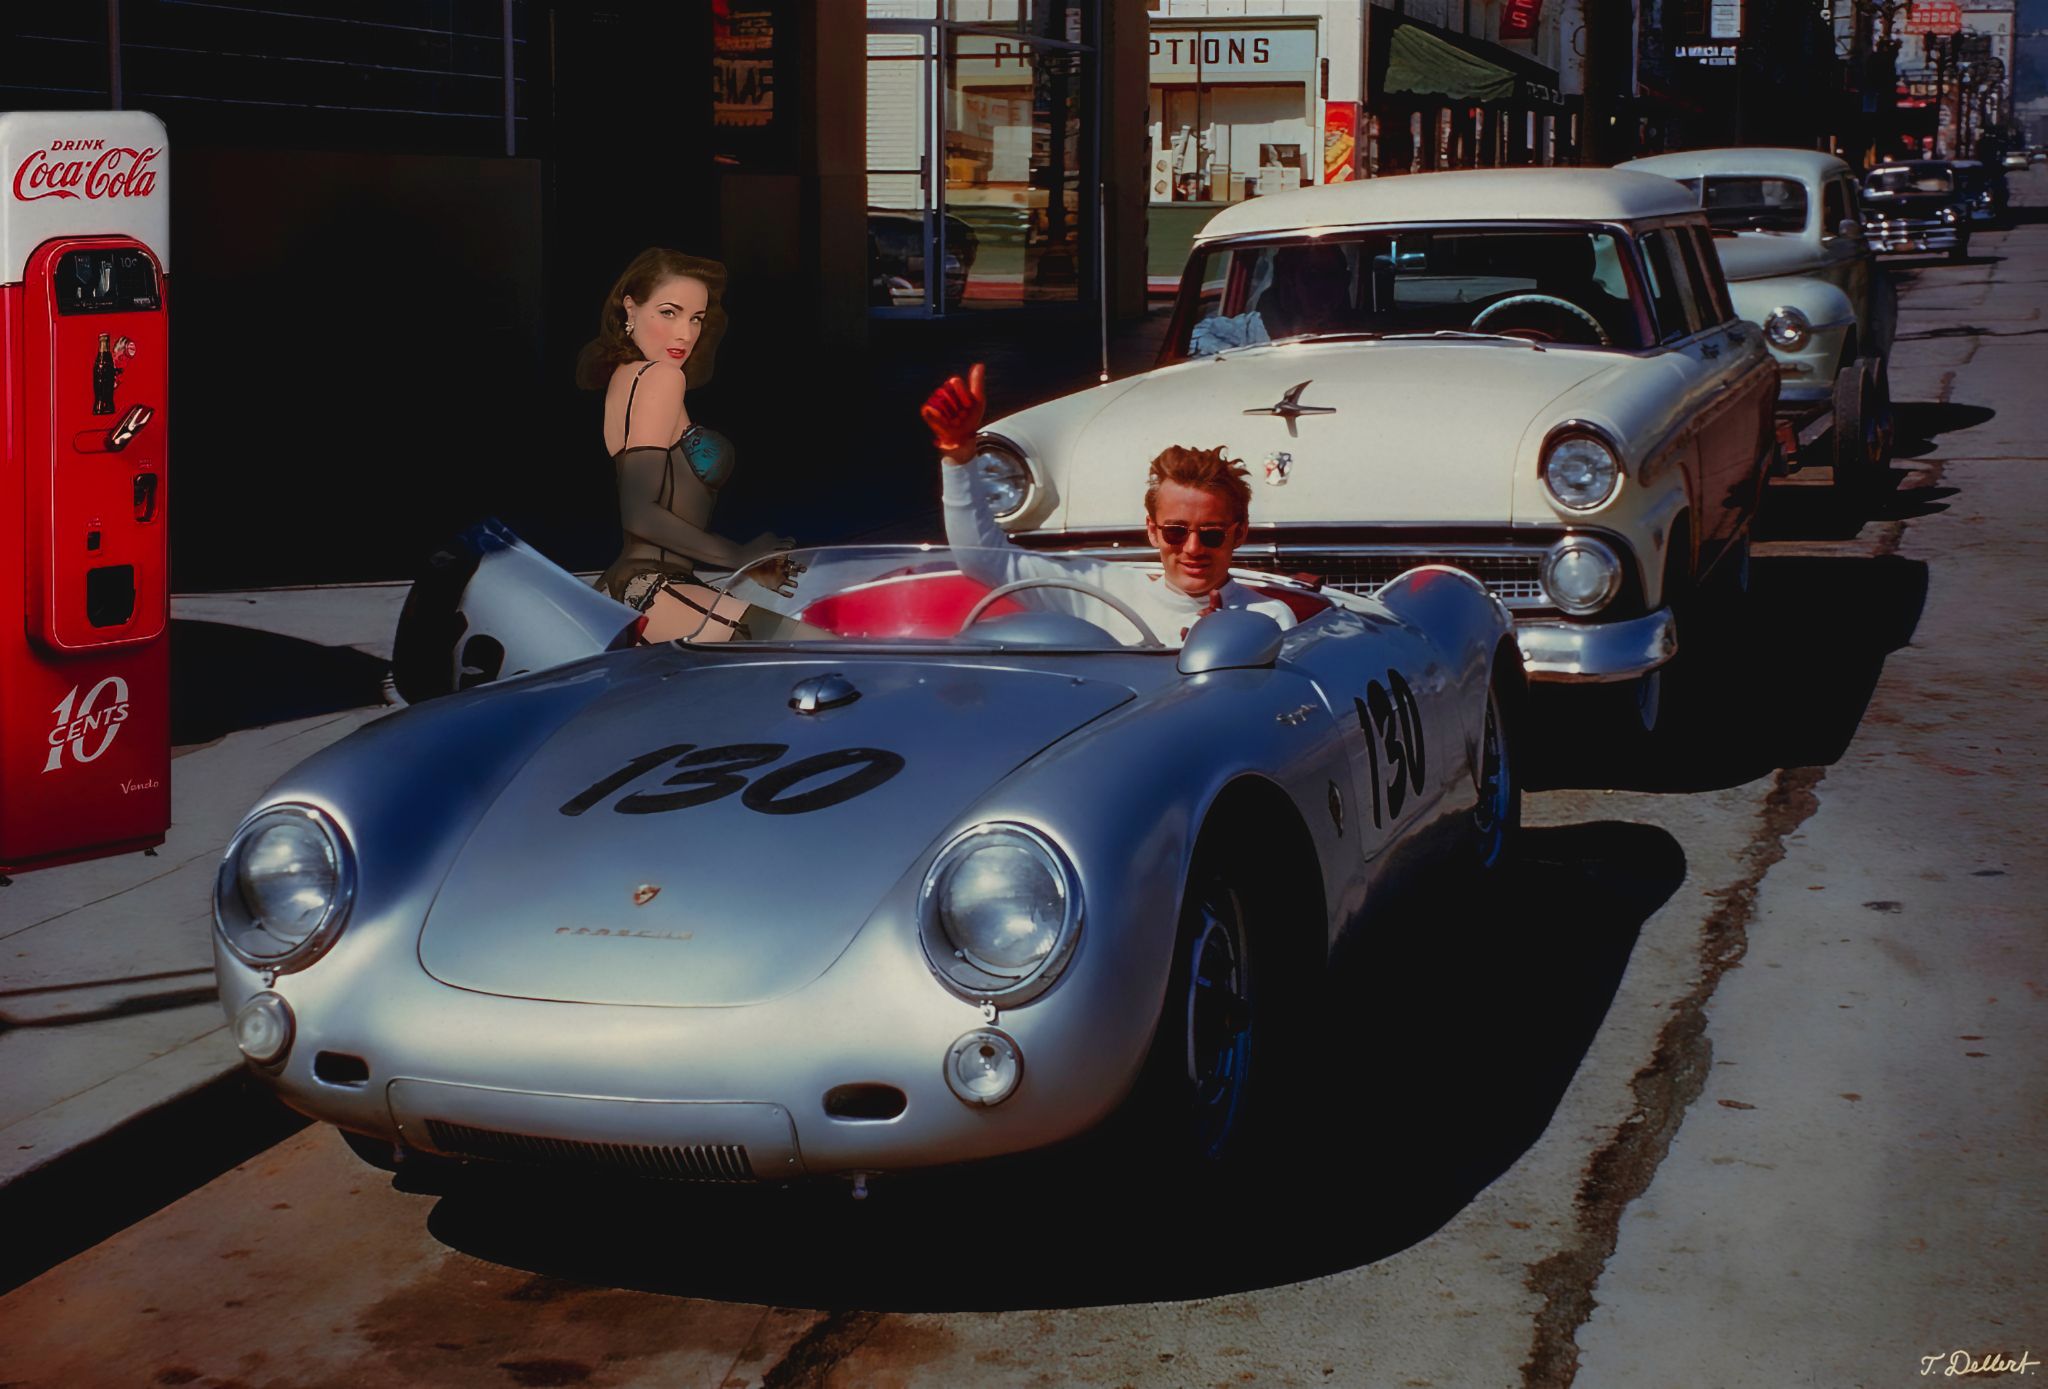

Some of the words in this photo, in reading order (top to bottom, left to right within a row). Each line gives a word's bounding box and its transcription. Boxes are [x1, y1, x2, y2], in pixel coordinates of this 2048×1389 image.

[12, 147, 163, 201] Coca-Cola
[51, 139, 105, 151] DRINK
[41, 676, 129, 775] 10
[48, 703, 130, 746] CENTS
[1353, 668, 1426, 830] 130
[558, 743, 906, 817] 130
